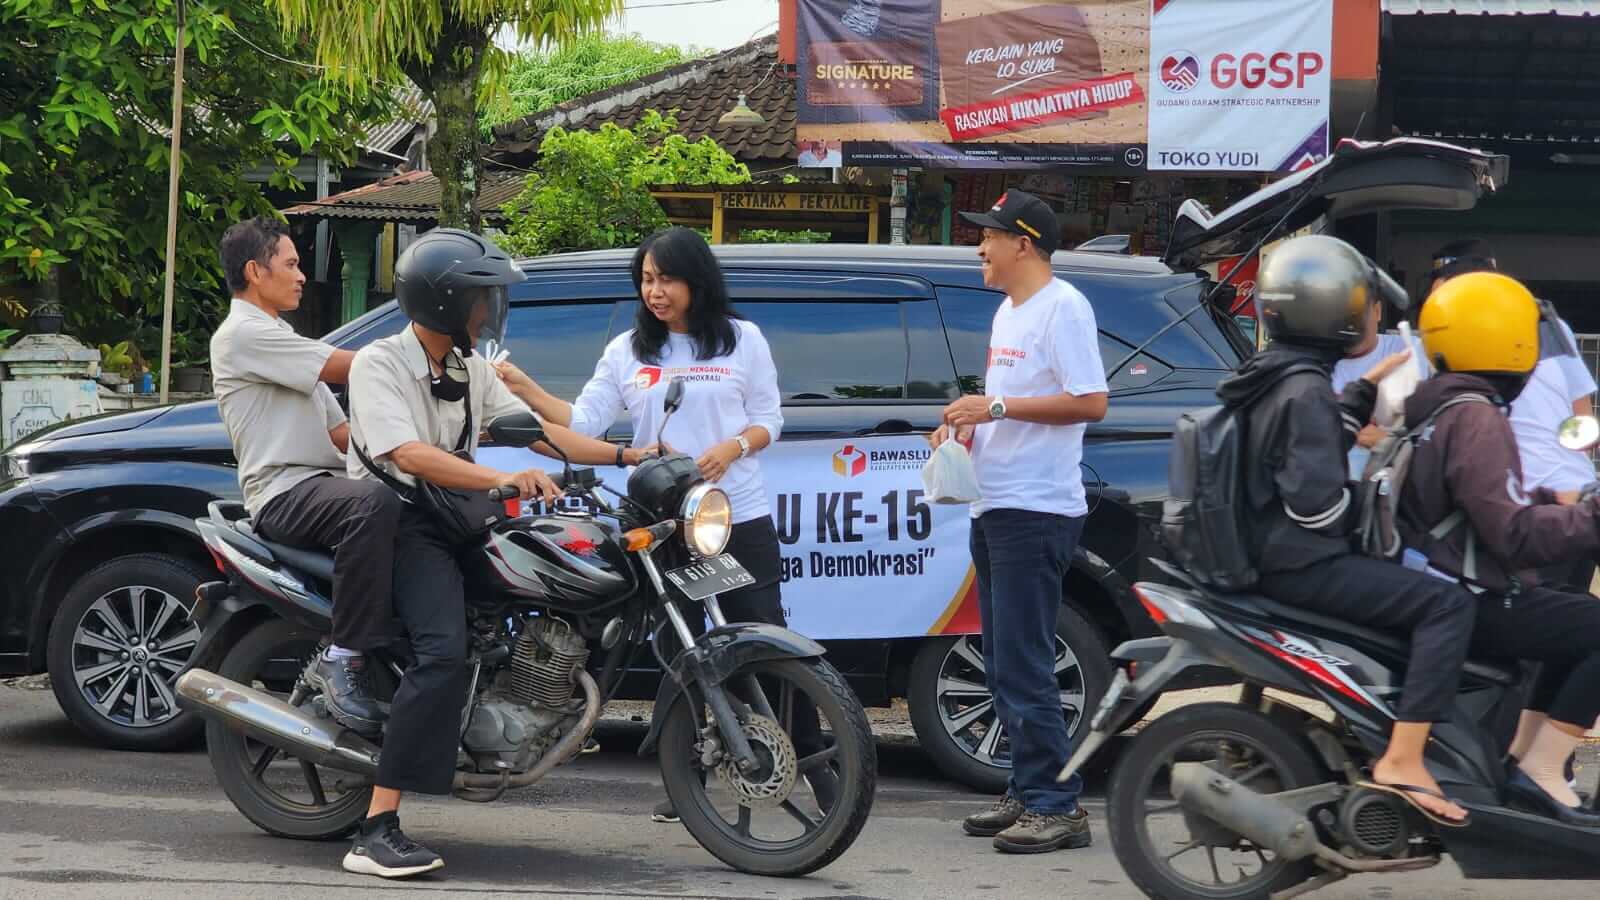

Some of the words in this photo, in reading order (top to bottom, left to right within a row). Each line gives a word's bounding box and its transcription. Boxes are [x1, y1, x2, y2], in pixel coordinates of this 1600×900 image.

[966, 43, 1025, 65] KERJAIN
[1025, 38, 1065, 57] YANG
[816, 64, 915, 80] SIGNATURE
[996, 61, 1016, 78] LO
[1017, 57, 1056, 76] SUKA
[1210, 52, 1324, 89] GGSP
[954, 105, 1009, 132] RASAKAN
[1011, 88, 1091, 121] NIKMATNYA
[1091, 79, 1133, 103] HIDUP
[1221, 98, 1264, 106] STRATEGIC
[1265, 98, 1321, 106] PARTNERSHIP
[1158, 151, 1211, 166] TOKO
[1215, 151, 1259, 167] YUDI
[720, 192, 787, 209] PERTAMAX
[870, 449, 932, 461] BAWASLU
[776, 493, 802, 545] U
[816, 489, 932, 544] KE-15
[684, 562, 717, 581] 6119
[780, 555, 803, 583] ga
